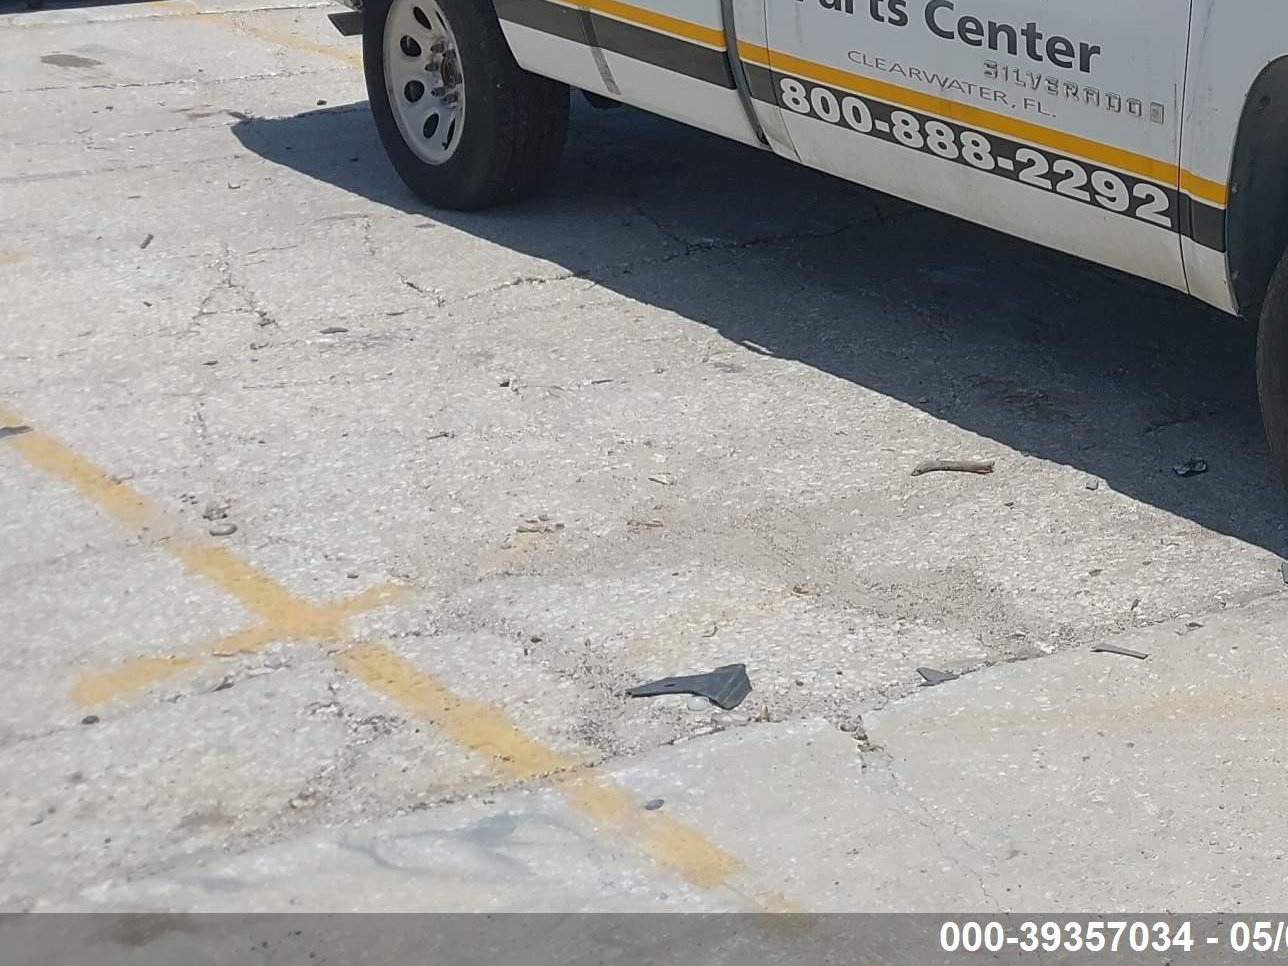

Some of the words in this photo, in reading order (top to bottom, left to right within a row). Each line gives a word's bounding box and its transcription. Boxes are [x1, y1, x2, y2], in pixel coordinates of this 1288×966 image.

[847, 50, 1016, 109] CLEARWATER,
[1022, 97, 1057, 118] FL.
[983, 59, 1142, 117] SILVERADO
[780, 77, 1172, 227] 800-888-2292
